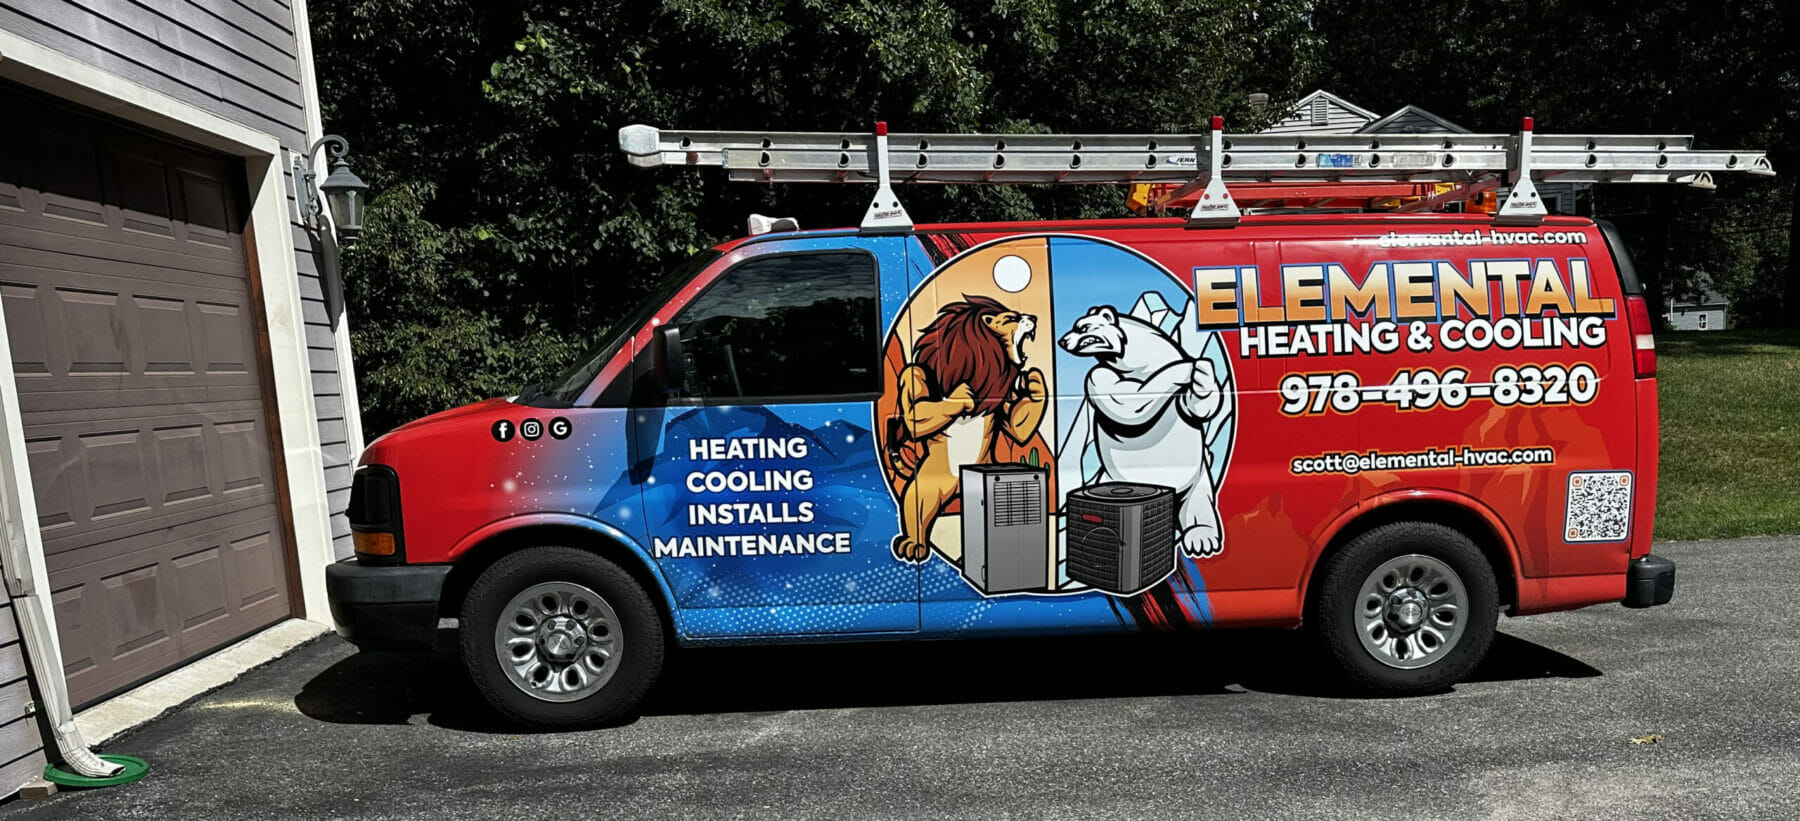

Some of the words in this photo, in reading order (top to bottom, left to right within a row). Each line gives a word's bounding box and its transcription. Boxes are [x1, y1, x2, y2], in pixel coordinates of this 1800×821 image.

[1378, 230, 1588, 247] elemental-hvac.com
[1194, 258, 1616, 328] ELEMENTAL
[1240, 320, 1398, 356] HEATING
[1408, 320, 1433, 351] &
[1440, 318, 1607, 350] COOLING
[1280, 364, 1598, 415] 978-496-8320
[689, 437, 808, 460] HEATING
[1292, 448, 1553, 474] scott@elemental-hvac.com
[686, 470, 814, 493] COOLING
[688, 502, 815, 526] INSTALLS
[654, 533, 852, 558] MAINTENANCE
